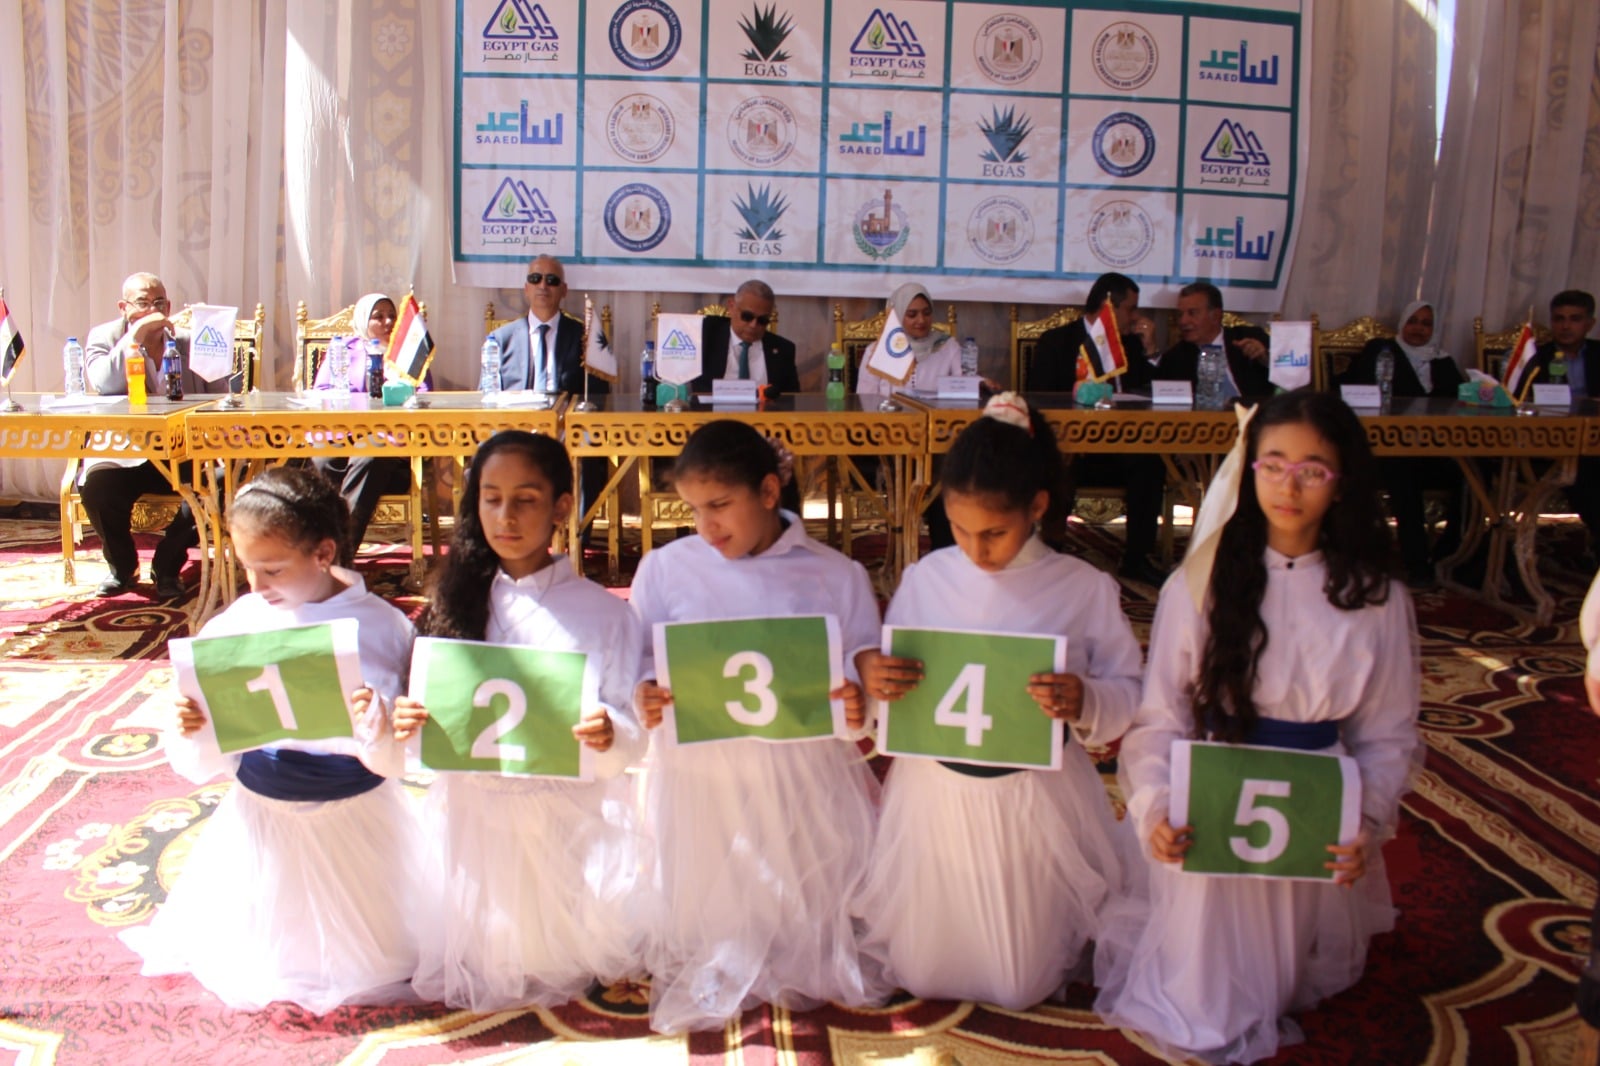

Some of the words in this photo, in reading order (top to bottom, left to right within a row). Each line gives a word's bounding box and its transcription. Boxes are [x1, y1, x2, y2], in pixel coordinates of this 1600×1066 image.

[483, 41, 528, 51] EGYPT
[532, 41, 559, 51] GAS
[850, 57, 895, 68] EGYPT
[898, 58, 925, 69] GAS
[744, 63, 787, 77] EGAS
[1199, 71, 1238, 82] SAAED
[476, 135, 518, 144] SAAED
[839, 145, 881, 155] SAAED
[982, 163, 1025, 178] EGAS
[1200, 164, 1242, 176] EGYPT
[1244, 166, 1270, 177] GAS
[482, 225, 528, 235] EGYPT
[530, 226, 557, 236] GAS
[738, 242, 782, 255] EGAS
[1194, 249, 1234, 260] SAAED
[721, 650, 778, 727] 3
[246, 663, 298, 730] 1
[934, 664, 993, 746] 4
[470, 678, 528, 760] 2
[1229, 778, 1291, 863] 5
